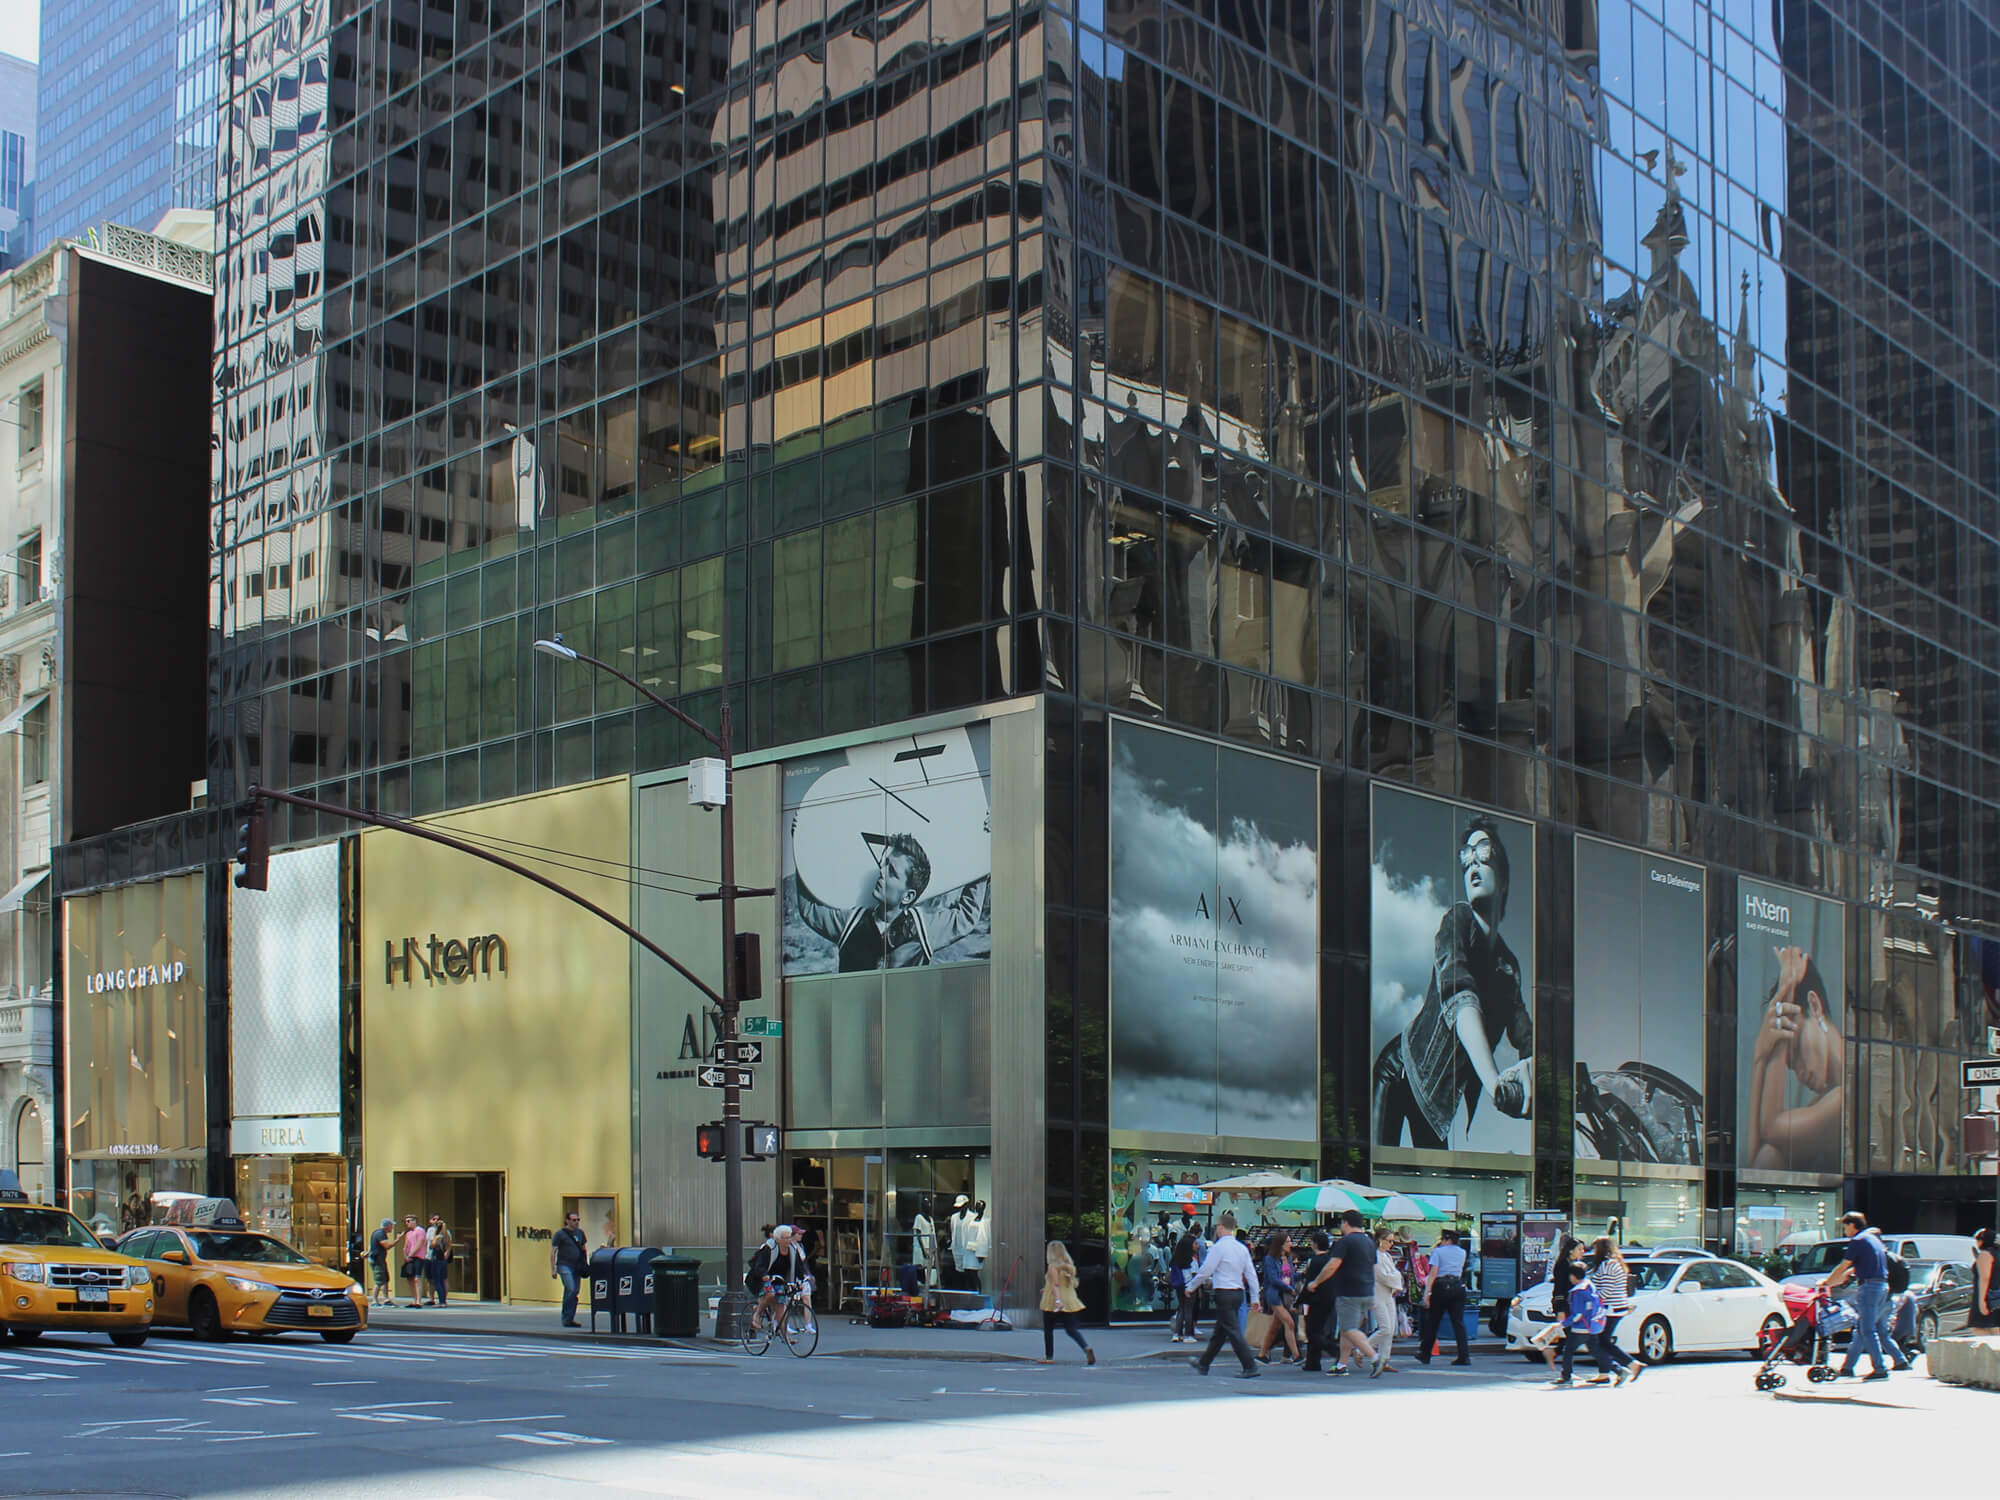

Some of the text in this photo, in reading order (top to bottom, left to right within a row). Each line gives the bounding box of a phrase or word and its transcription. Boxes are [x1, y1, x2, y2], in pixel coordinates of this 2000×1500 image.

[1169, 933, 1270, 959] ARMANI EXCHANGE
[87, 961, 185, 994] LONGCHAMP
[746, 1018, 754, 1032] 5
[740, 1047, 756, 1058] WAY
[706, 1072, 723, 1082] ONE
[1974, 1068, 1998, 1079] ONE
[261, 1127, 307, 1146] FURLA
